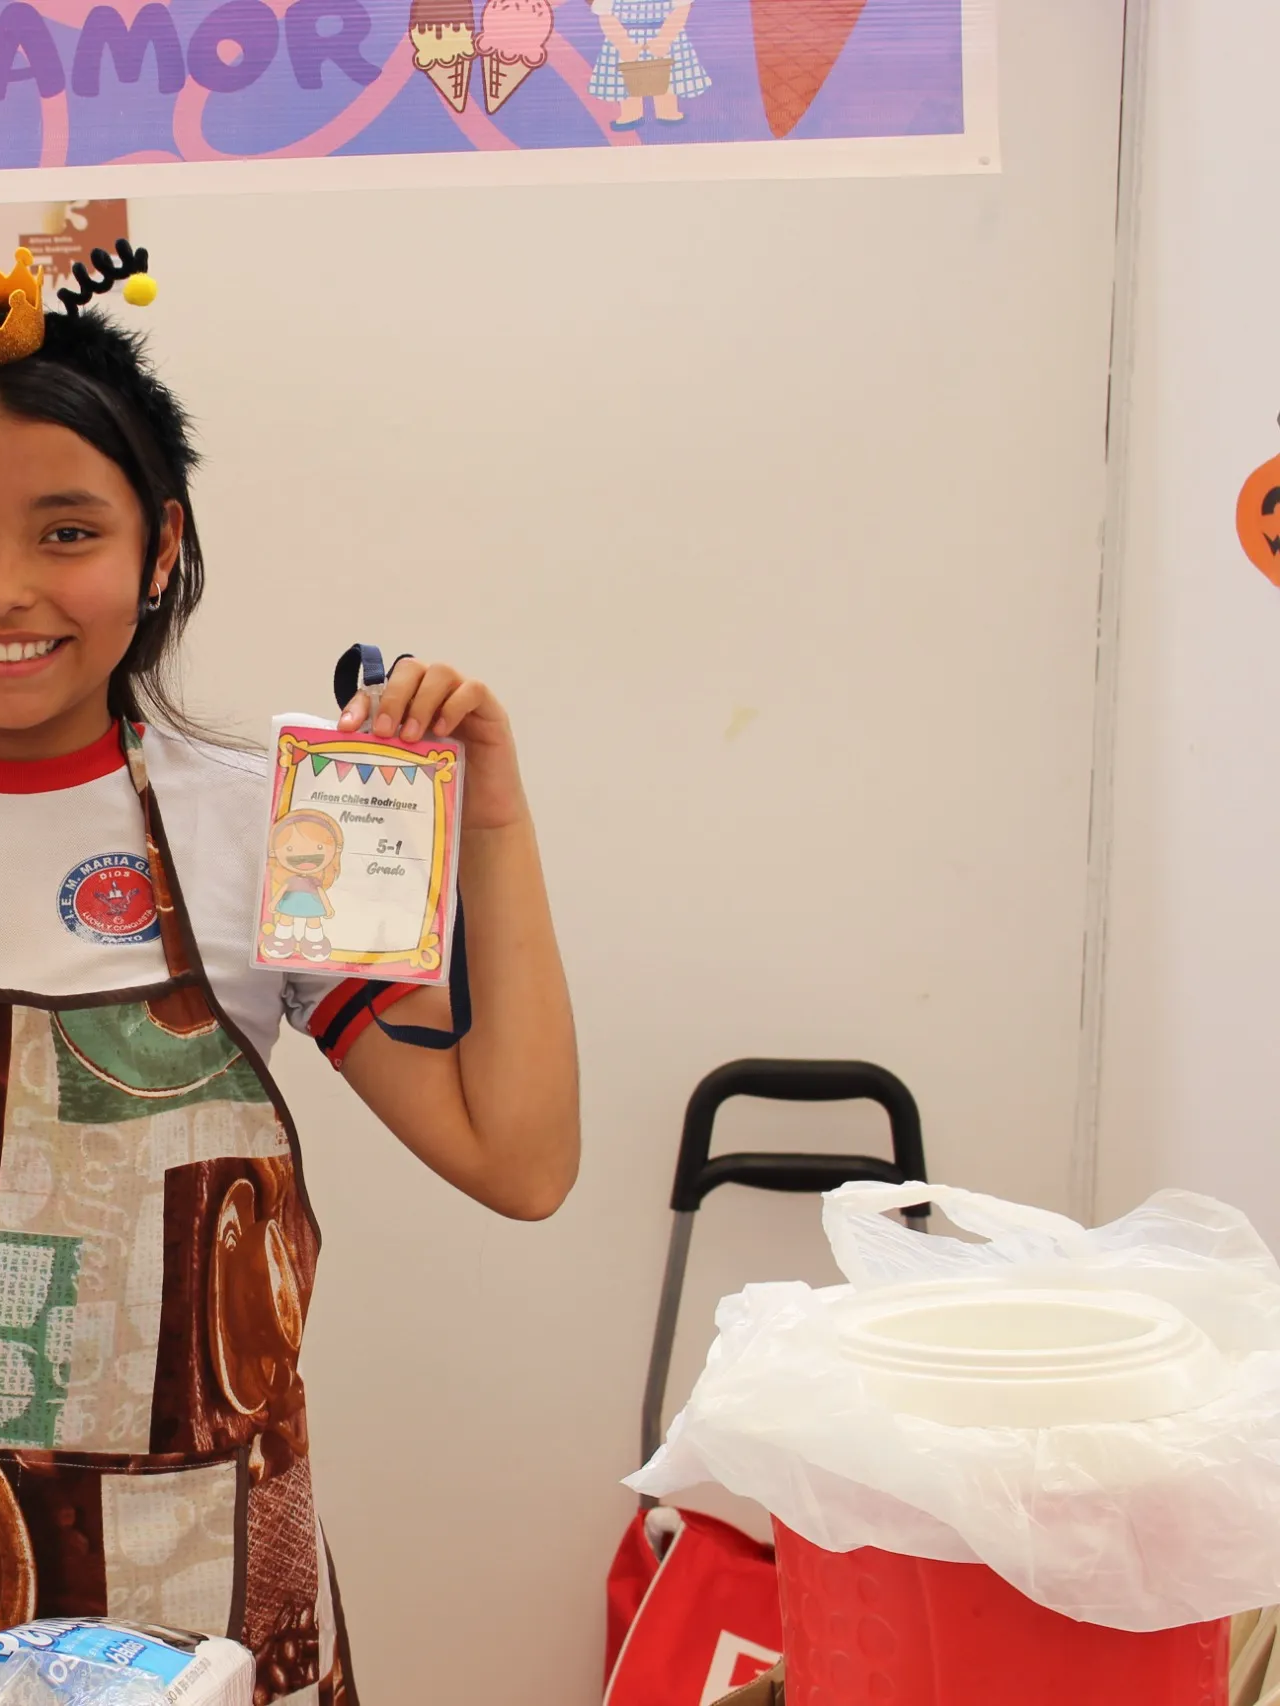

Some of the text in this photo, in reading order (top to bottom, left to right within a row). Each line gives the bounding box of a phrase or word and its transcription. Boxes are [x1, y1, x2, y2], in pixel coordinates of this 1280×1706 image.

[310, 790, 340, 803] Alison
[370, 796, 418, 811] Rodriguez
[339, 809, 385, 824] Nombre
[376, 838, 403, 856] 5-1
[80, 857, 129, 876] MARIA
[100, 870, 131, 880] DIOS
[366, 861, 406, 877] Grado
